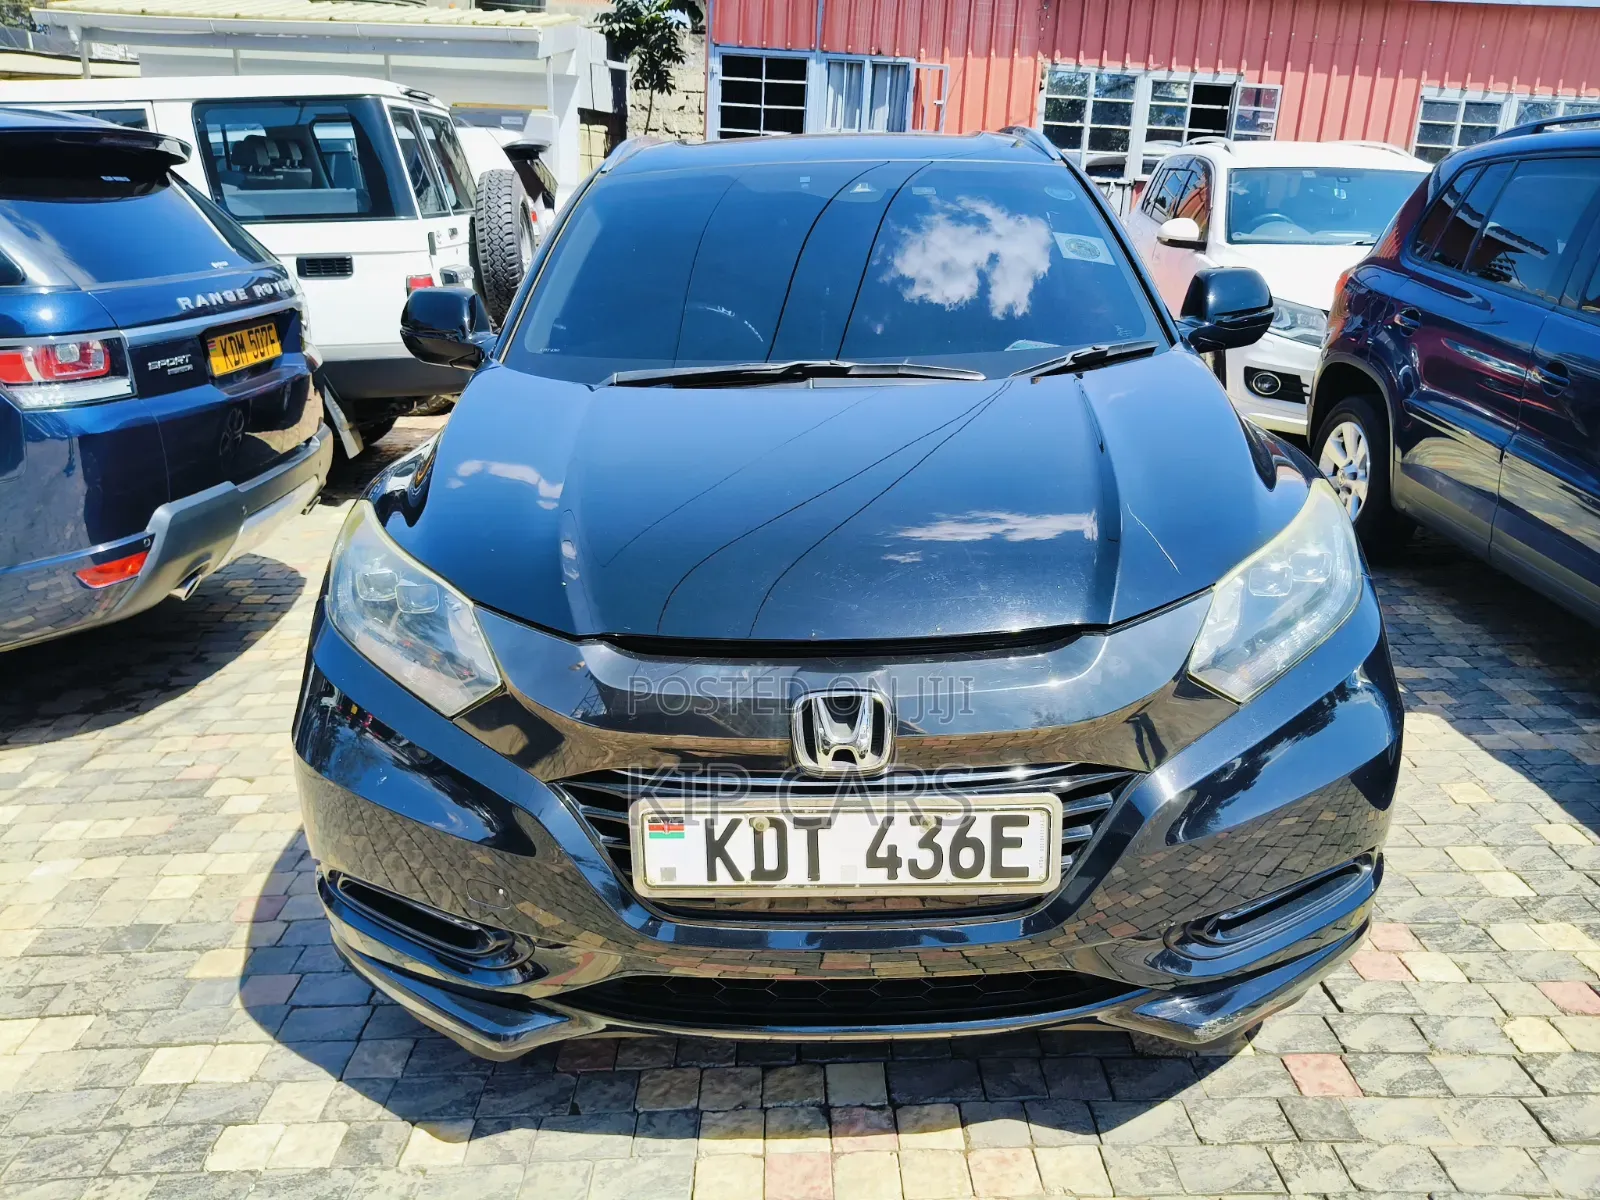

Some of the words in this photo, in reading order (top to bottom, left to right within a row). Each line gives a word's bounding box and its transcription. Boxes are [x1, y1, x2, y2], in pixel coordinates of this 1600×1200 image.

[177, 288, 249, 310] RANGE
[148, 354, 192, 371] SPORT
[219, 333, 249, 369] KDM
[704, 816, 832, 882] KDT
[865, 814, 1030, 880] 436E
